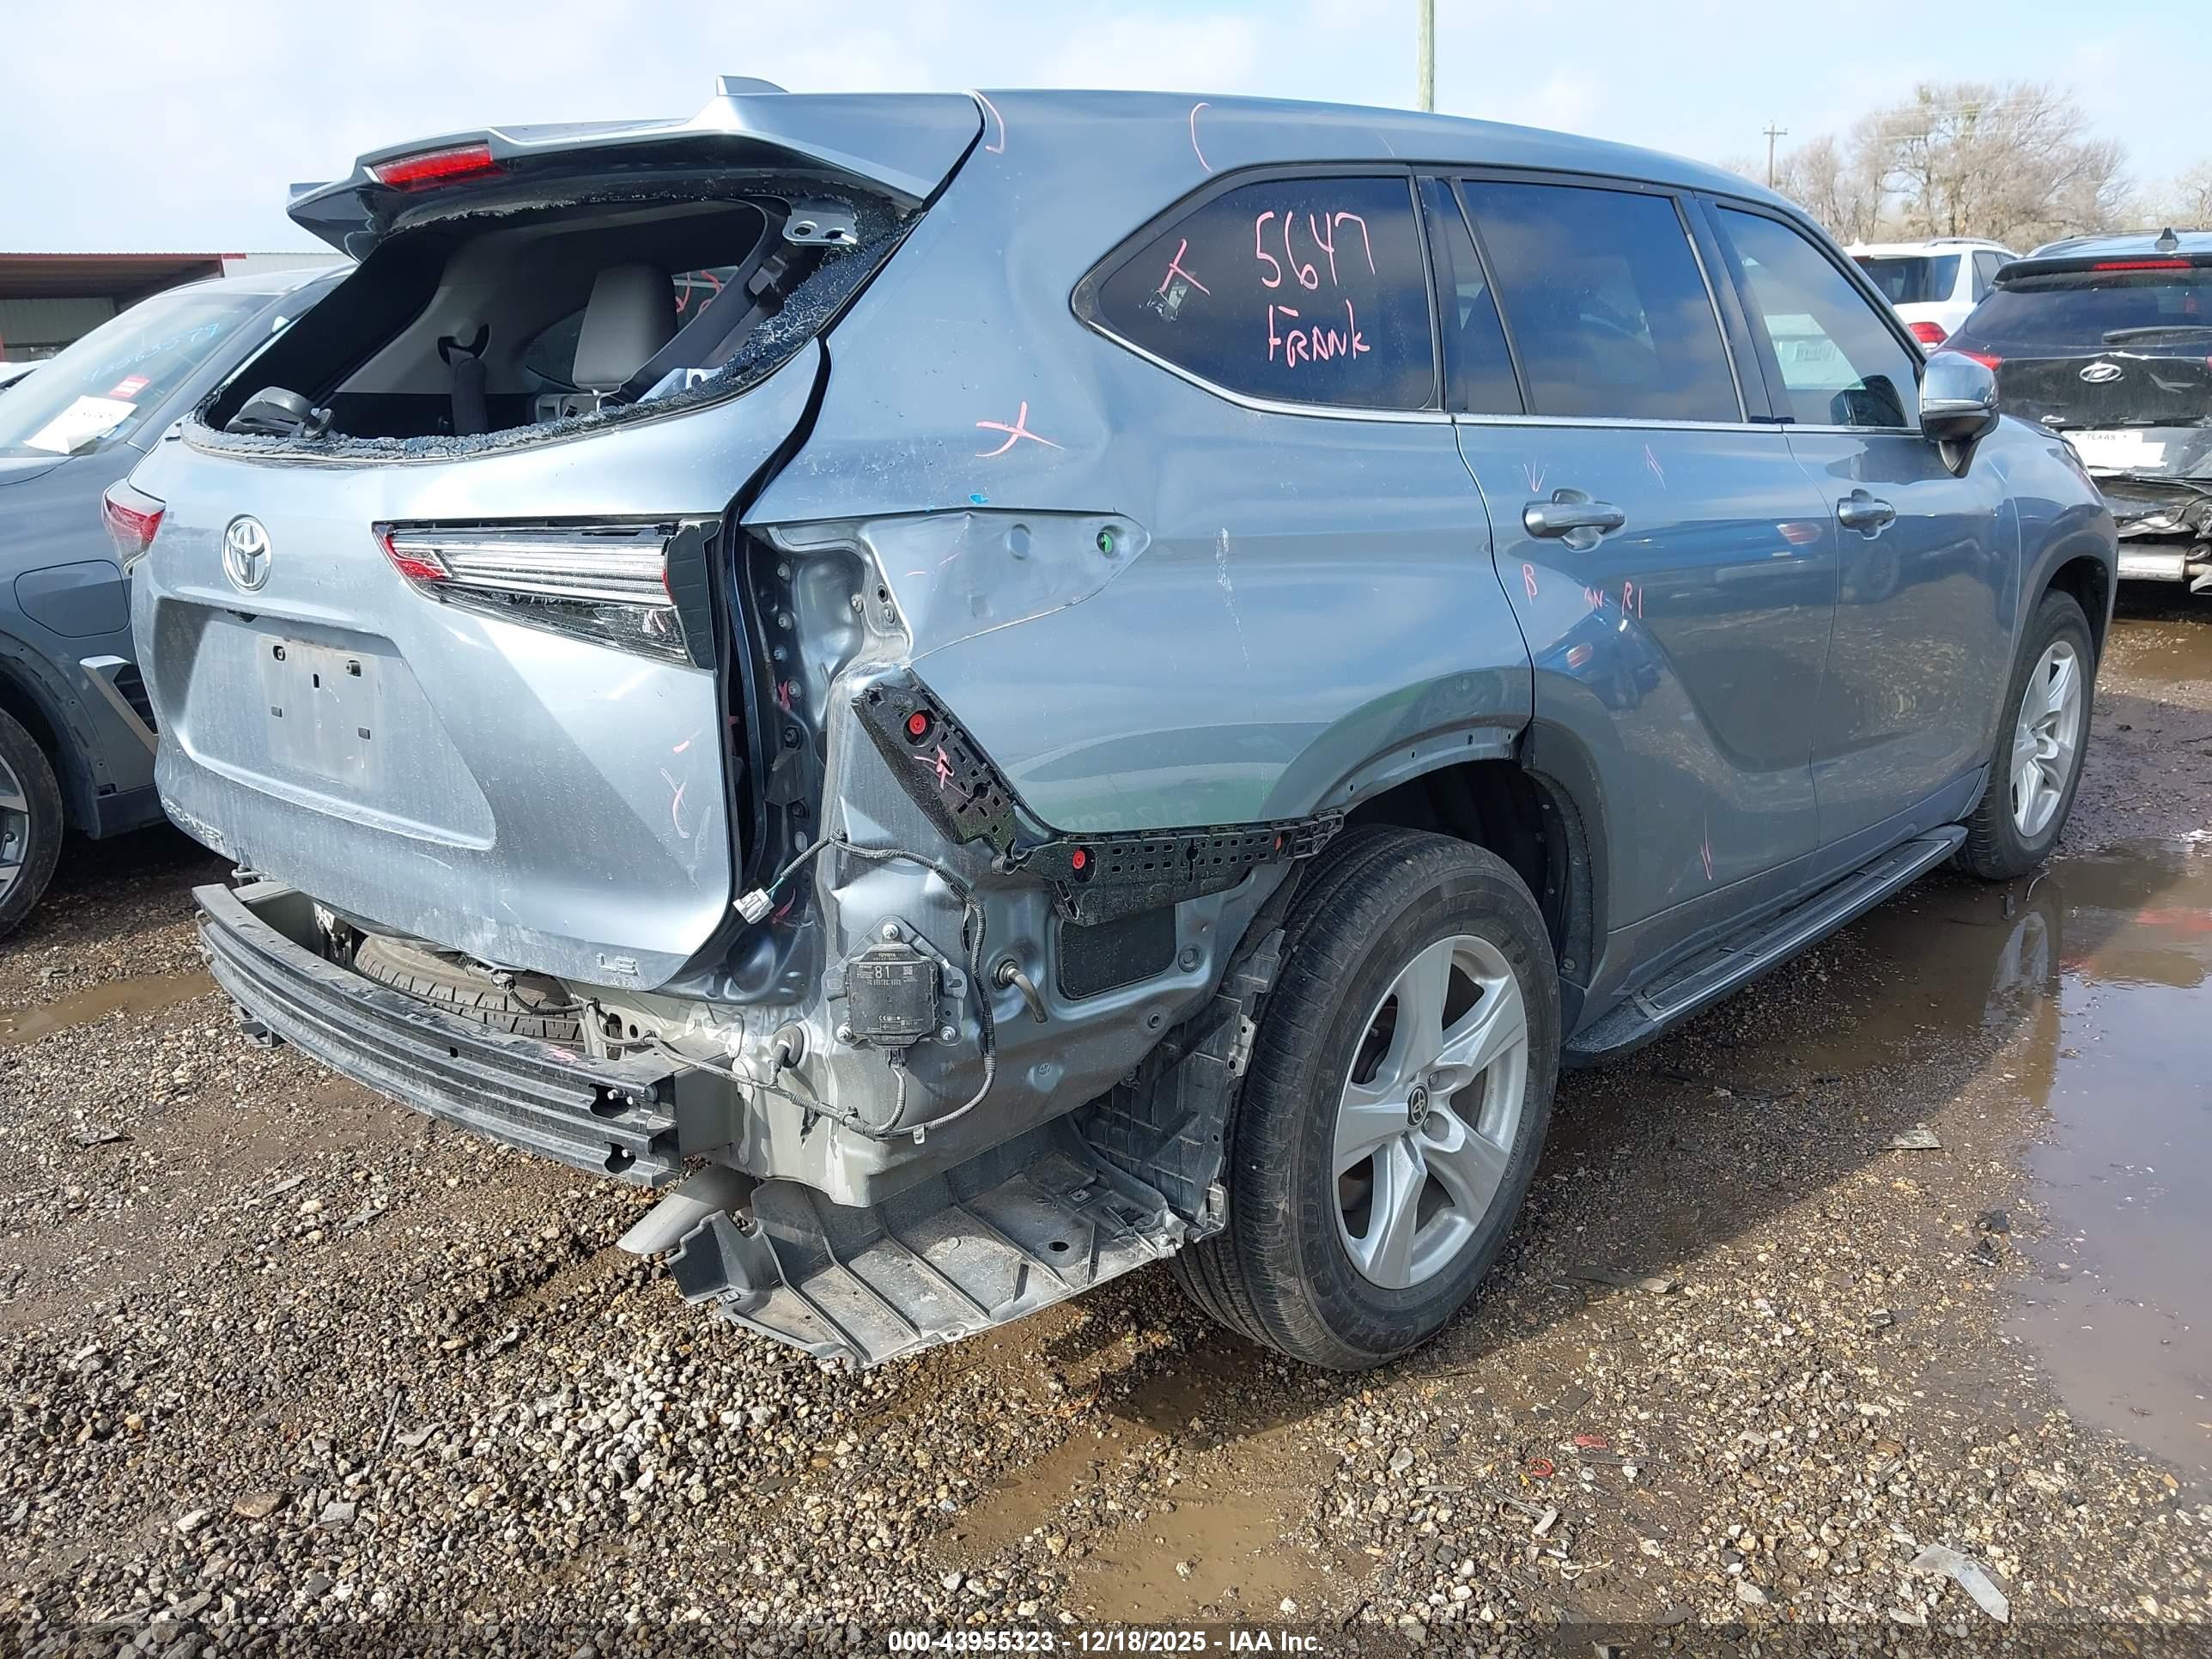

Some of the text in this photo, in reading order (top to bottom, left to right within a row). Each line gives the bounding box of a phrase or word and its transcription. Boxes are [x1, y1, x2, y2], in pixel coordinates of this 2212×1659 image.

[1255, 210, 1376, 289] 5647
[595, 952, 640, 977] LE
[874, 964, 890, 979] 81
